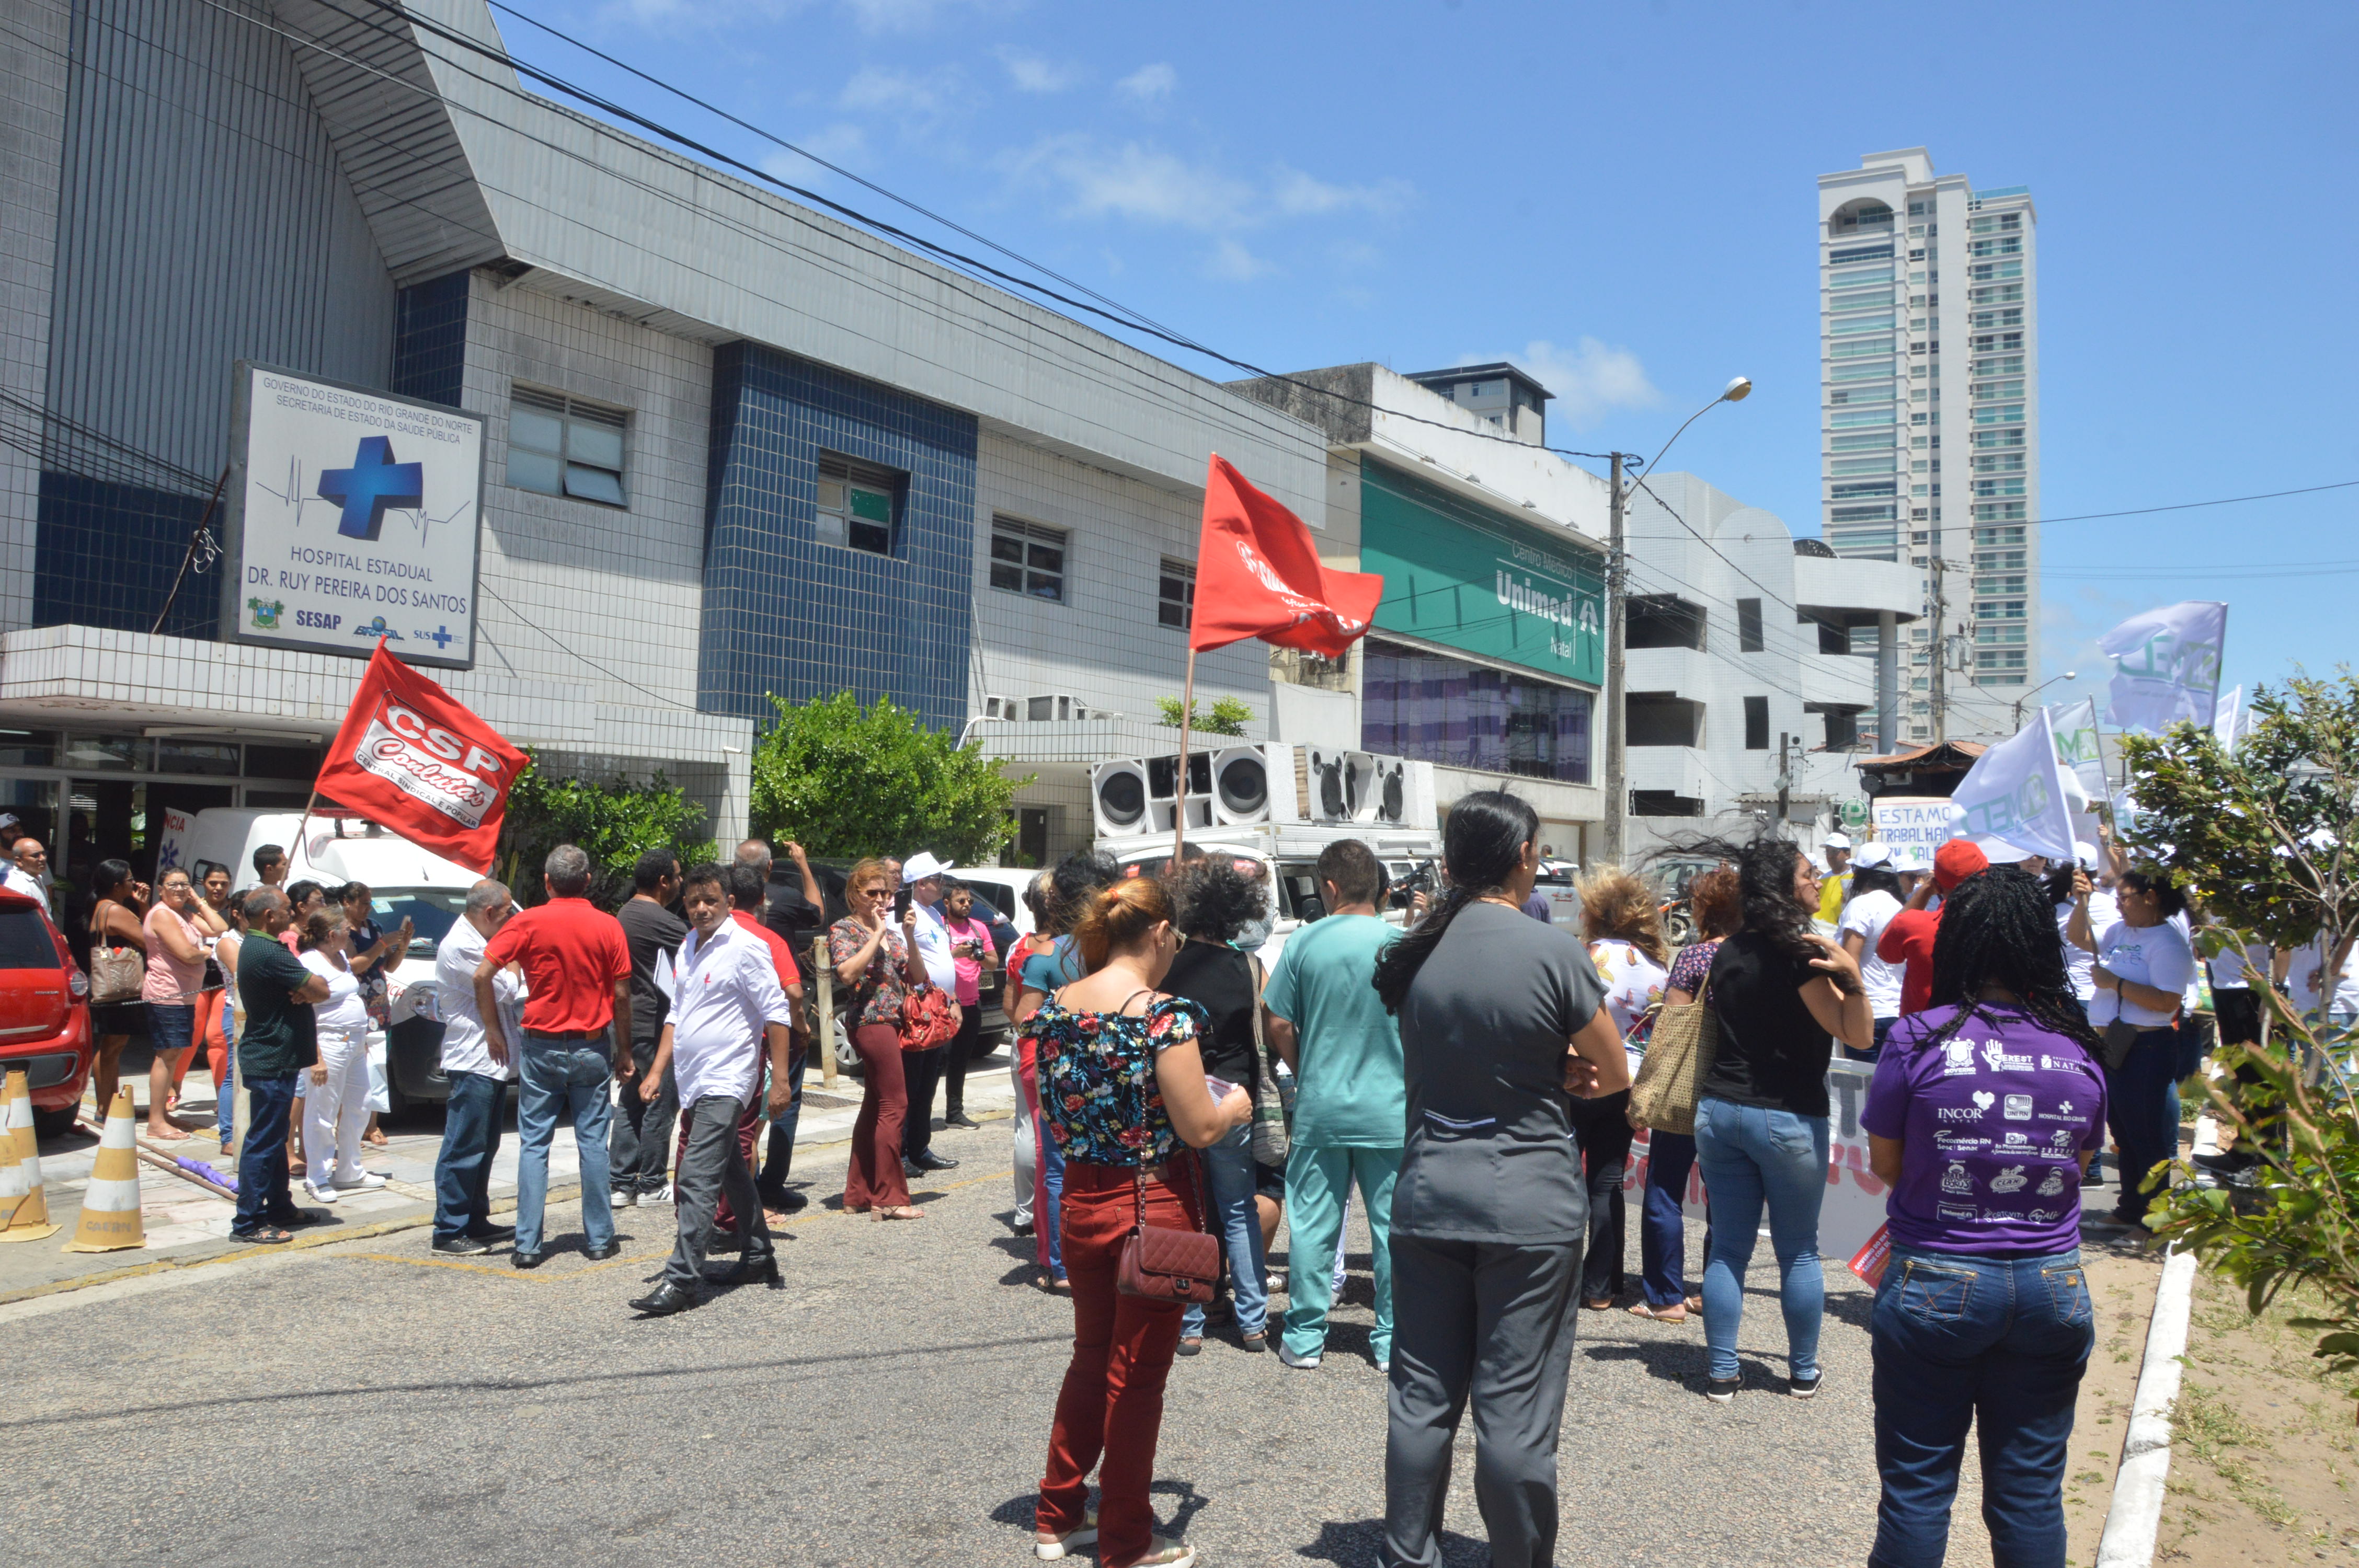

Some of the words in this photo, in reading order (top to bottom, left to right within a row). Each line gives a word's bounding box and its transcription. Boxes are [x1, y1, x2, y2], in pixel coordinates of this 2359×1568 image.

[264, 377, 310, 396] GOVERNO
[312, 388, 325, 400] DO
[327, 392, 362, 409] ESTADO
[364, 400, 376, 412] DO
[379, 404, 393, 416] RIO
[395, 408, 429, 424] GRANDE
[431, 416, 444, 427] DO
[445, 418, 473, 434] NORTE
[277, 395, 333, 416] SECRETARIA
[334, 408, 346, 419] DE
[348, 411, 382, 426] ESTADO
[384, 419, 396, 430] DA
[397, 422, 425, 436] SAÚDE
[427, 428, 461, 444] PÚBLICA
[291, 546, 361, 571] HOSPITAL
[367, 558, 433, 582] ESTADUAL
[1513, 540, 1541, 567] Centro
[248, 566, 273, 586] DR.
[280, 570, 310, 591] RUY
[315, 576, 371, 601] PEREIRA
[376, 585, 407, 605] DOS
[412, 591, 466, 614] SANTOS
[1496, 569, 1572, 627] Unimed
[296, 609, 342, 630] SESAP
[414, 630, 430, 640] SUS
[1551, 636, 1572, 658] Natal
[387, 706, 500, 773] CSP
[372, 737, 485, 808] Conlutas
[358, 754, 395, 779] CENTRAL
[398, 777, 436, 803] SINDICAL
[445, 804, 476, 827] POPULAR
[1938, 1108, 1983, 1119] INCOR
[1996, 1178, 2020, 1186] CLAN
[1941, 1209, 1965, 1217] Unimed
[1854, 1248, 1875, 1270] GOVERNO
[1873, 1241, 1881, 1249] DO
